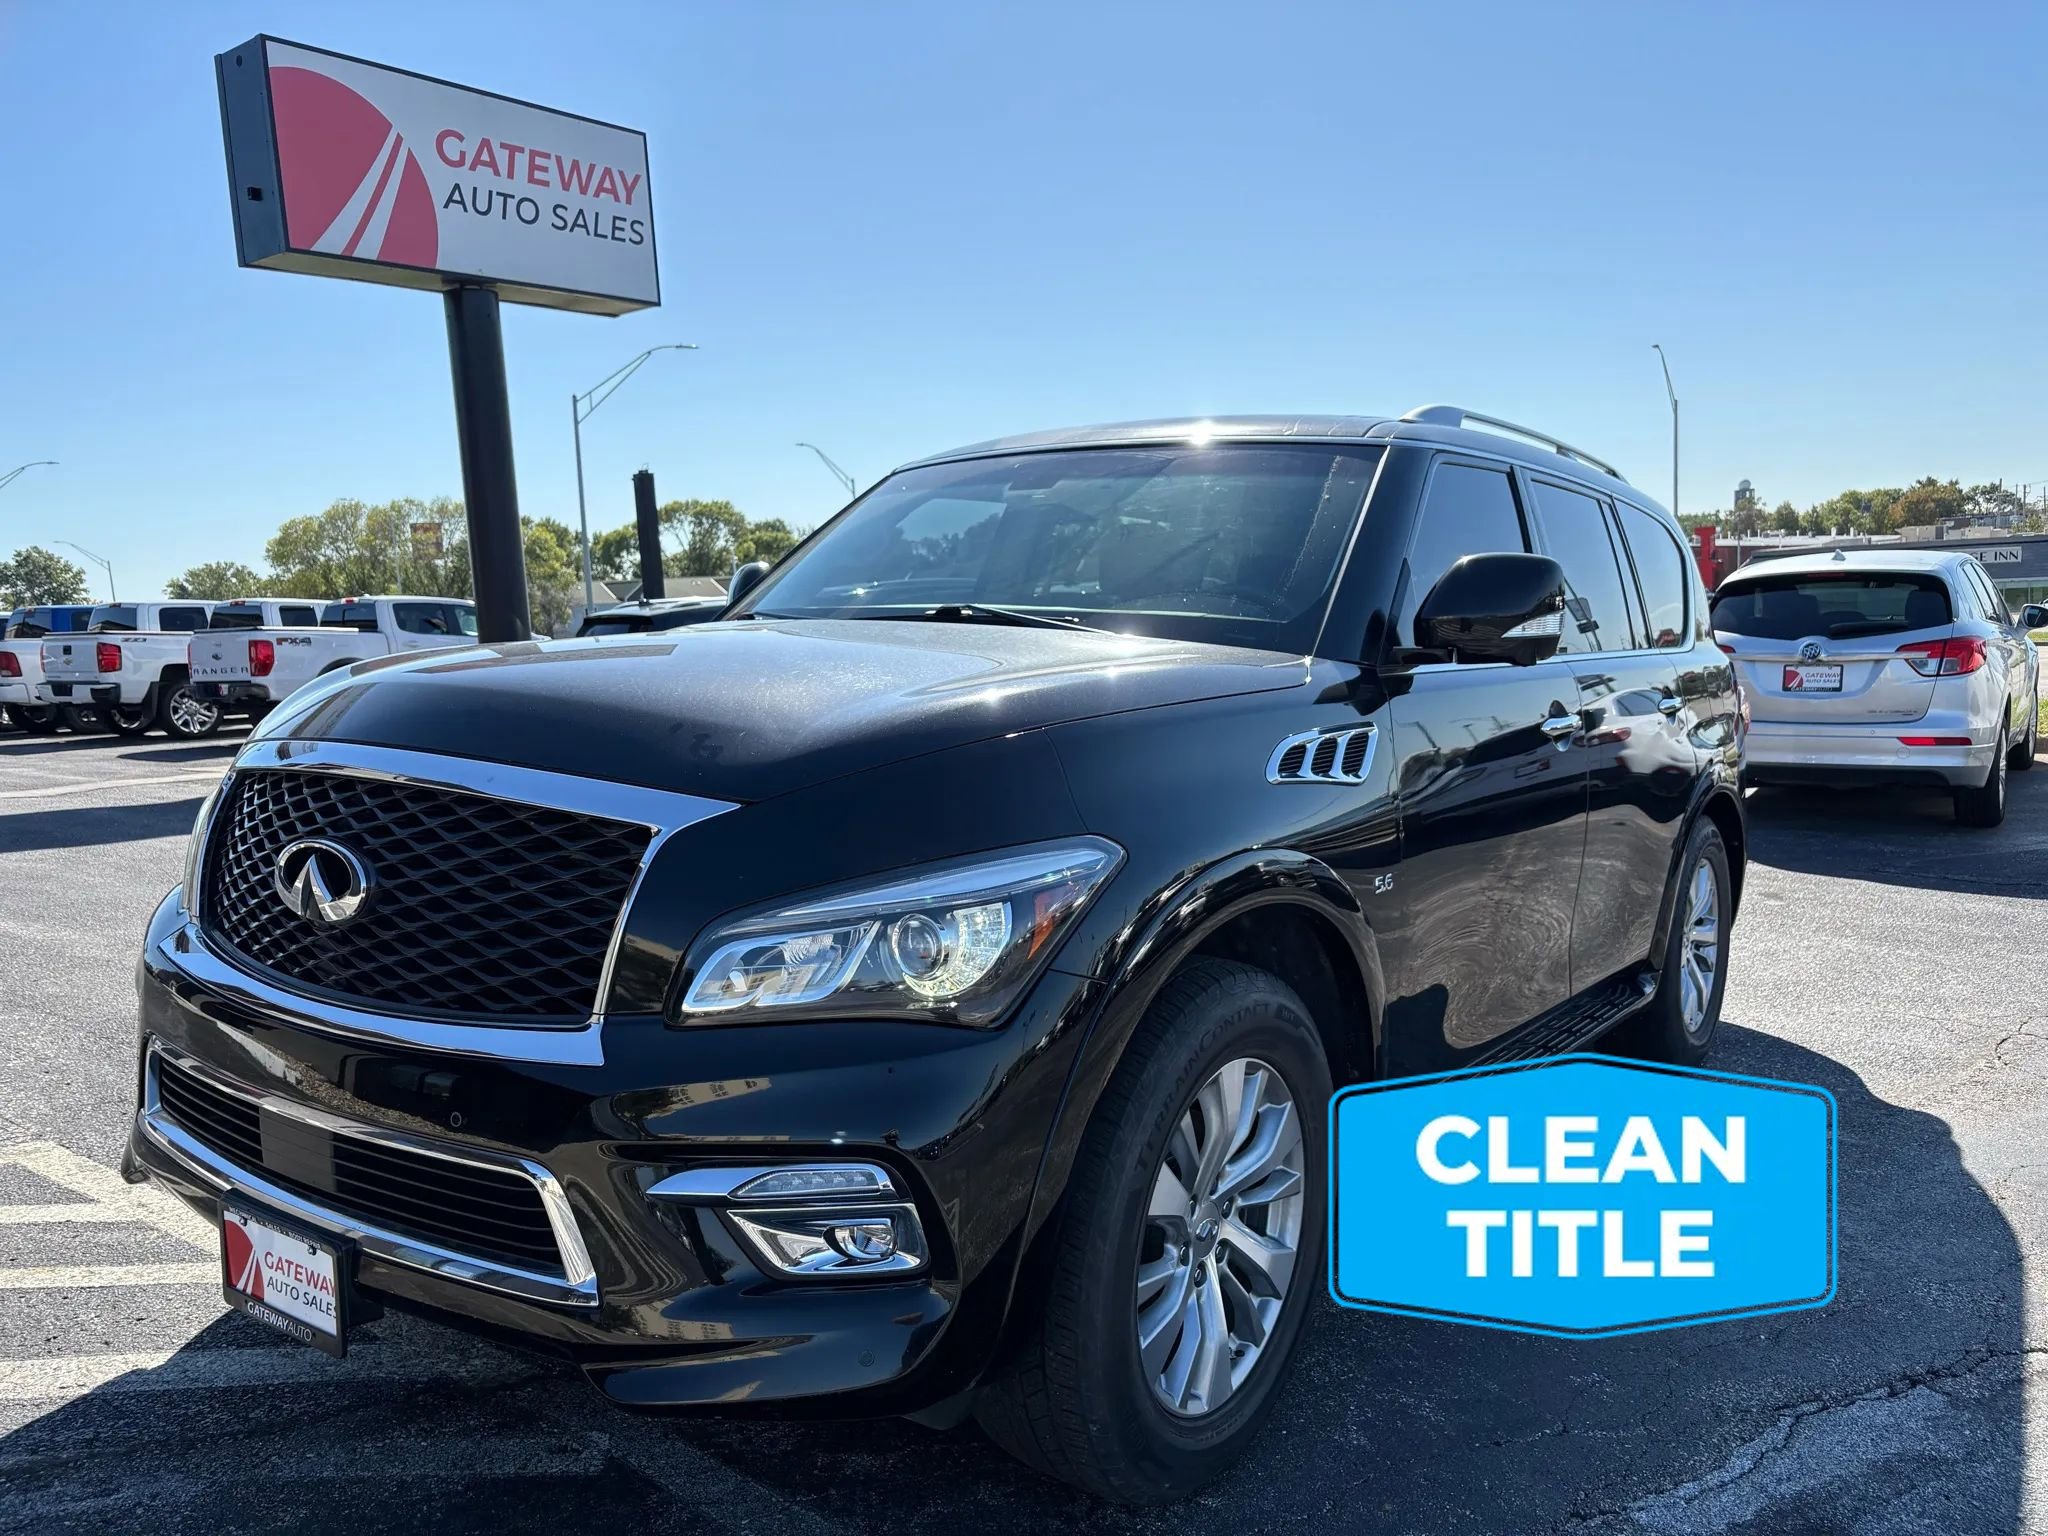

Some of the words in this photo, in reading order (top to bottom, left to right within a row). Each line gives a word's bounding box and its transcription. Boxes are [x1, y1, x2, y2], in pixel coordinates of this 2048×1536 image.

[435, 128, 642, 205] GATEWAY
[443, 183, 540, 225] AUTO
[551, 204, 645, 246] SALES
[1994, 550, 2019, 561] INN
[193, 666, 249, 675] RANGER
[264, 1251, 336, 1298] GATEWAY
[266, 1276, 300, 1301] AUTO
